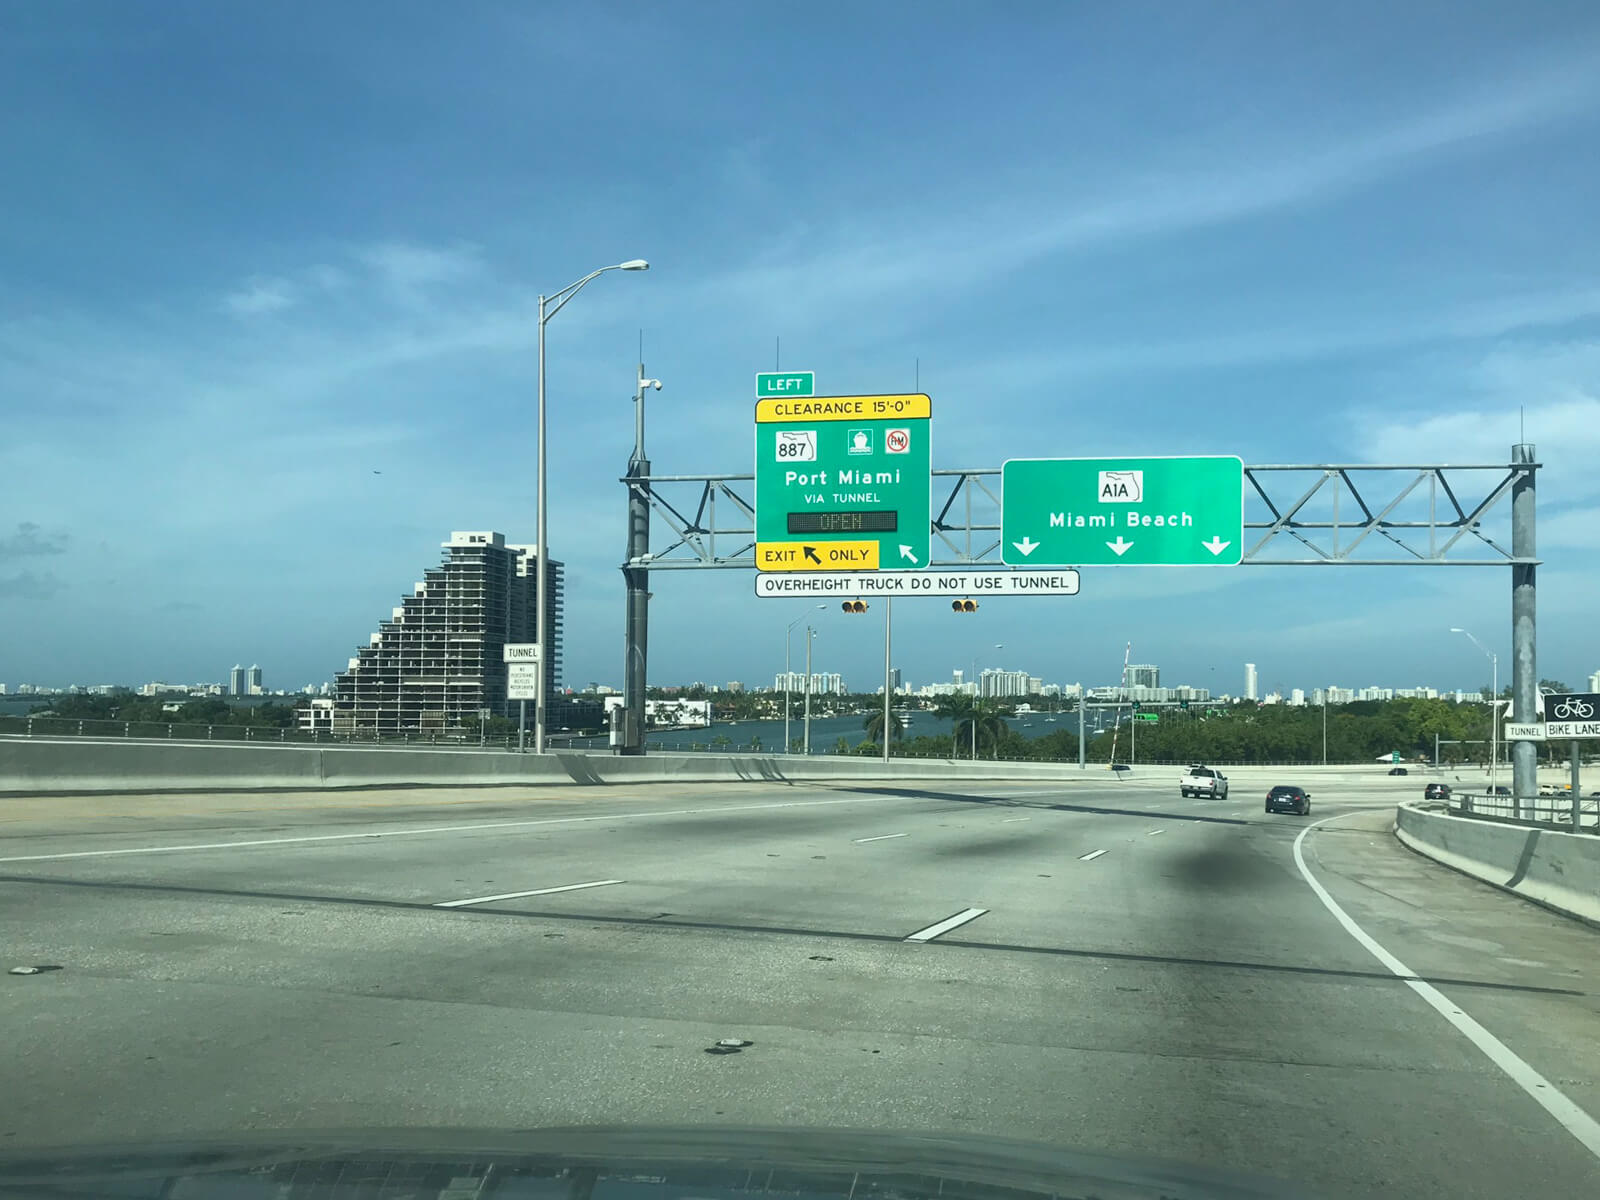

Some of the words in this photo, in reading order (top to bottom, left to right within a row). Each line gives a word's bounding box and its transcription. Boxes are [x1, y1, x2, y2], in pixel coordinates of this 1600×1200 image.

[768, 378, 803, 391] LEFT
[775, 402, 863, 416] CLEARANCE
[873, 400, 911, 413] 15'-0"
[778, 443, 806, 457] 887
[785, 470, 827, 487] Port
[838, 469, 901, 485] Miami
[1101, 483, 1129, 498] A1A
[804, 494, 825, 504] VIA
[832, 492, 881, 503] TUNNEL
[820, 514, 862, 530] OPEN
[1050, 512, 1115, 527] Miami
[1127, 511, 1193, 527] Beach
[765, 550, 796, 562] EXIT
[829, 549, 869, 561] ONLY
[765, 579, 851, 591] OVERHEIGHT
[858, 578, 904, 590] TRUCK
[911, 578, 931, 589] DO
[938, 577, 967, 589] NOT
[974, 577, 1002, 589] USE
[1011, 577, 1069, 589] TUNNEL
[508, 648, 537, 657] TUNNEL
[1510, 727, 1541, 736] TUNNEL
[1549, 724, 1571, 735] BIKE
[1575, 724, 1600, 735] LANE
